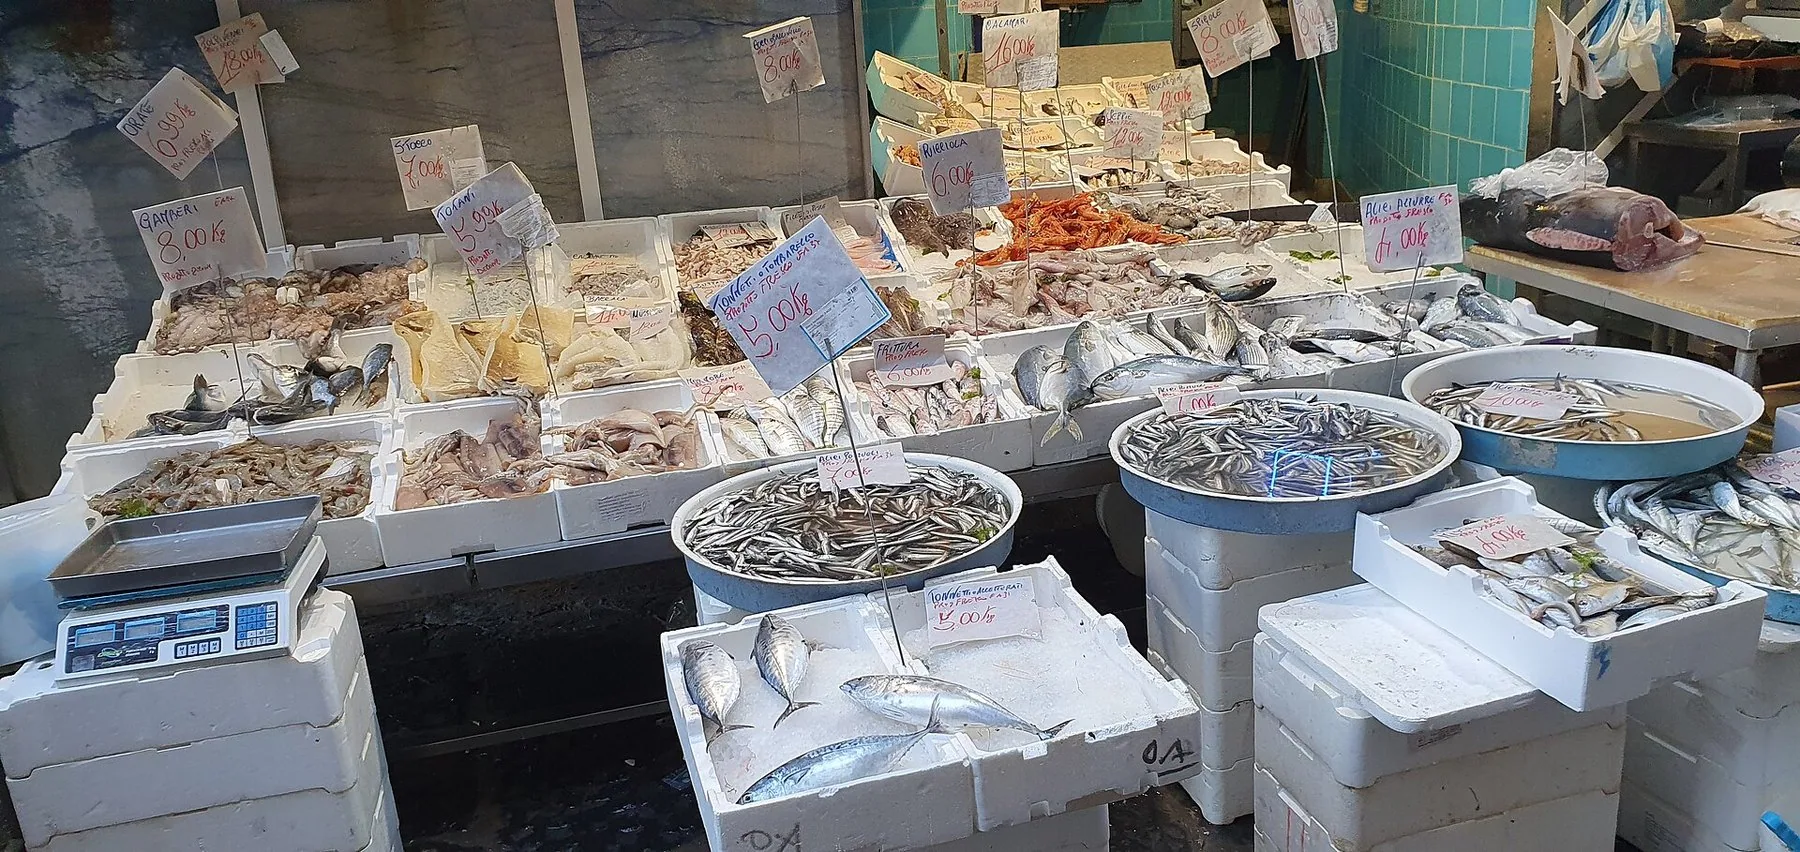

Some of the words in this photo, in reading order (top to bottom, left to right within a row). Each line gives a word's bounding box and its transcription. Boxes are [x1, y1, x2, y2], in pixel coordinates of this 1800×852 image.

[985, 17, 1029, 31] CALAMARI
[122, 99, 154, 136] ORATE
[394, 138, 432, 155] STOCCO
[436, 187, 476, 221] TOTANI
[139, 203, 199, 233] GAMBERI
[877, 341, 919, 360] FRITTURA
